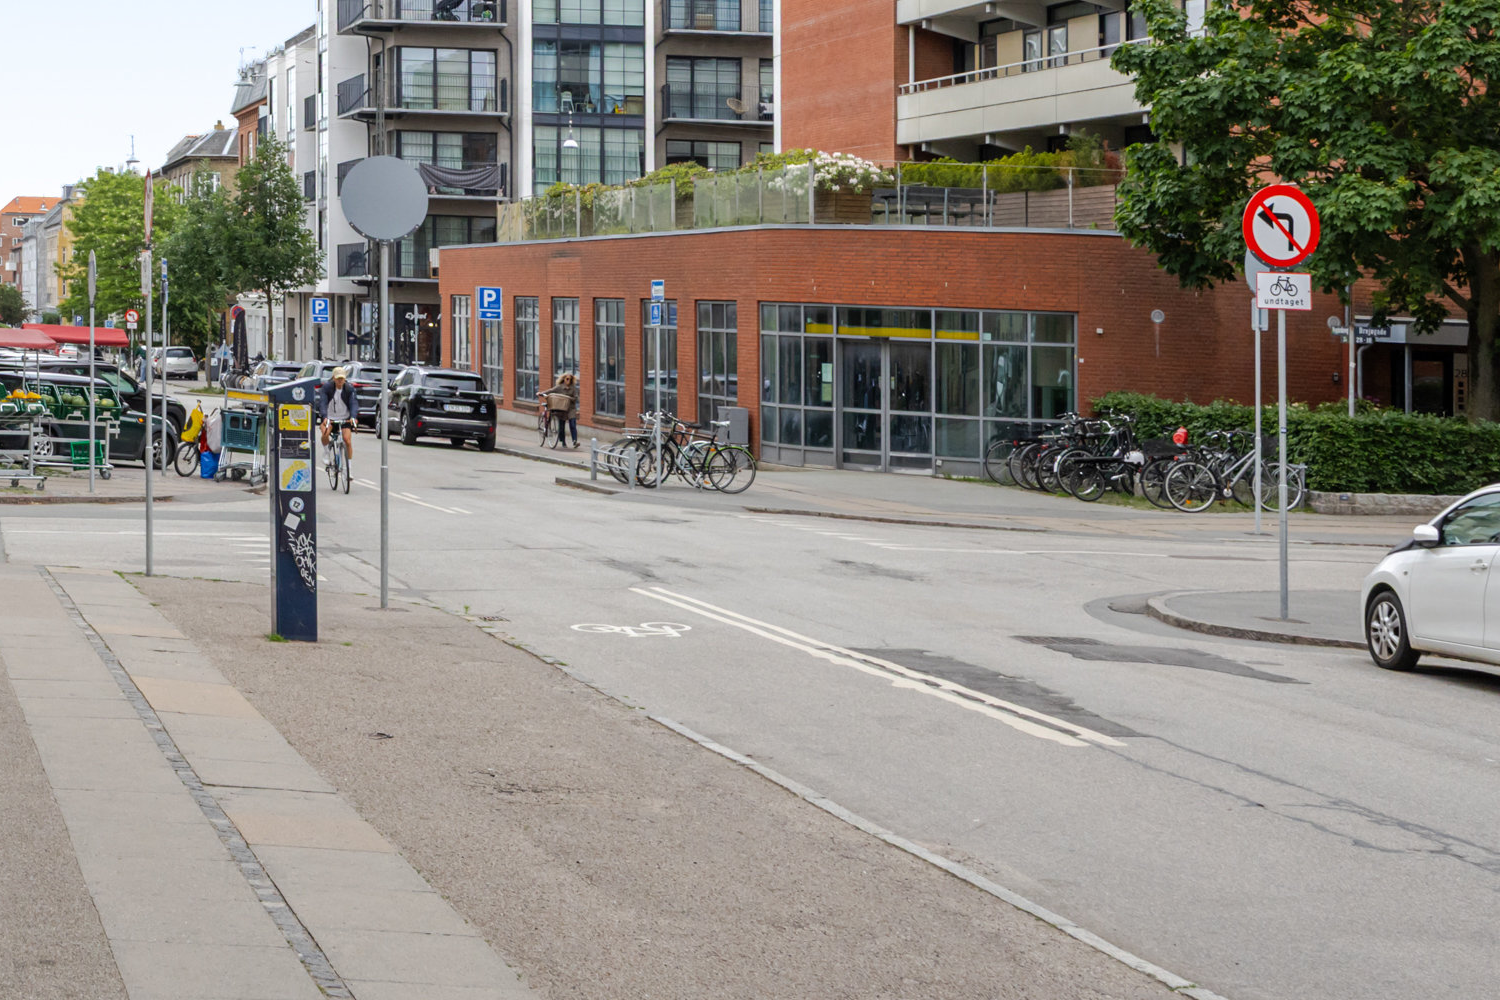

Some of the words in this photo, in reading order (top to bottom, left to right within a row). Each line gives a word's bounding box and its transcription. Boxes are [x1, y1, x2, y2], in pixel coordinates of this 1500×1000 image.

[483, 289, 497, 308] P
[1264, 298, 1304, 307] undtaget
[315, 300, 326, 314] P
